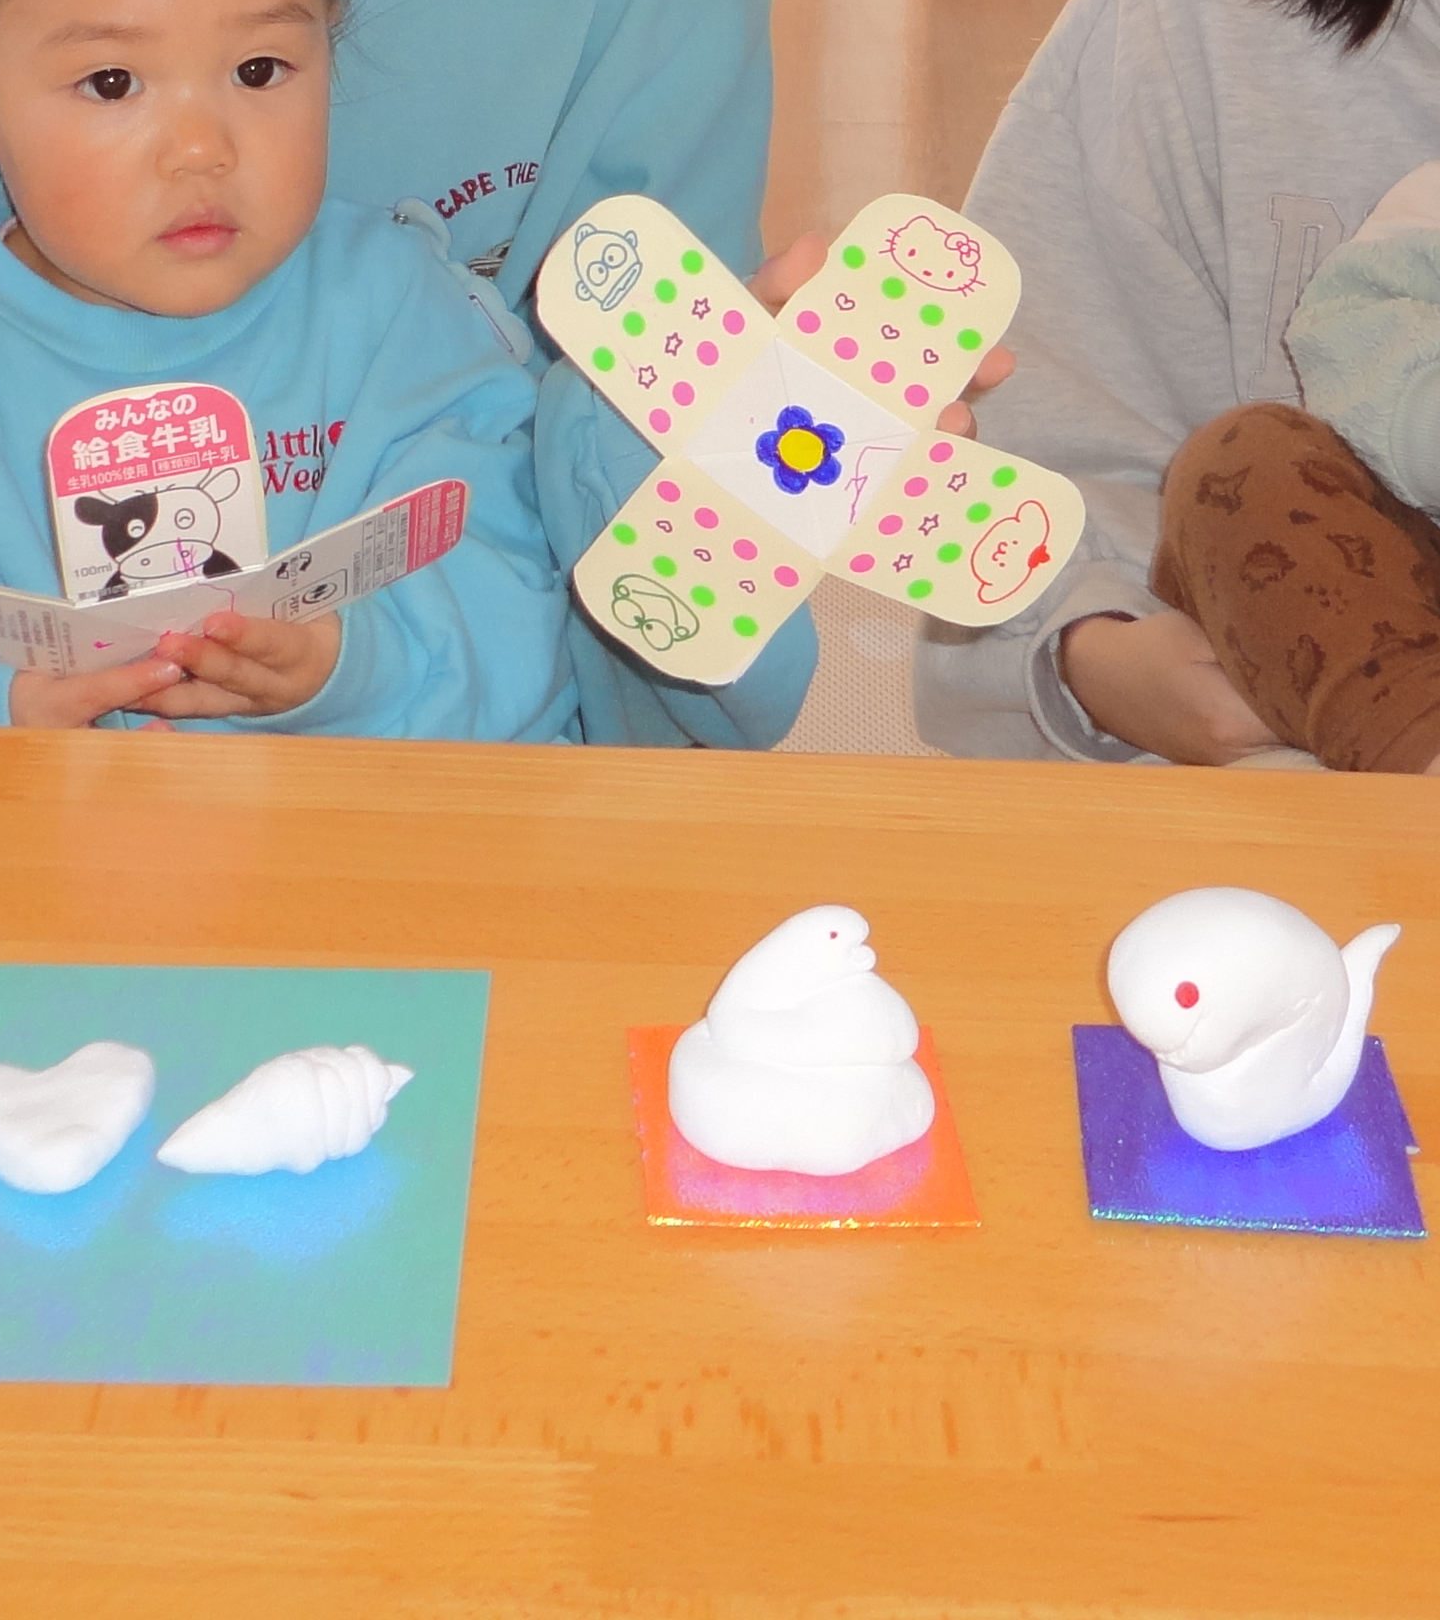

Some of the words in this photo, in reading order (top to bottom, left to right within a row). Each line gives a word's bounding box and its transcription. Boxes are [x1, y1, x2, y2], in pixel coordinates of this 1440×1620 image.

[434, 172, 497, 219] CAPE
[504, 162, 539, 188] THE
[94, 394, 197, 431] みんなの
[72, 414, 228, 471] 給食牛乳
[67, 463, 149, 491] 生乳100%使用
[201, 444, 240, 465] 牛乳
[74, 563, 113, 578] 100ml
